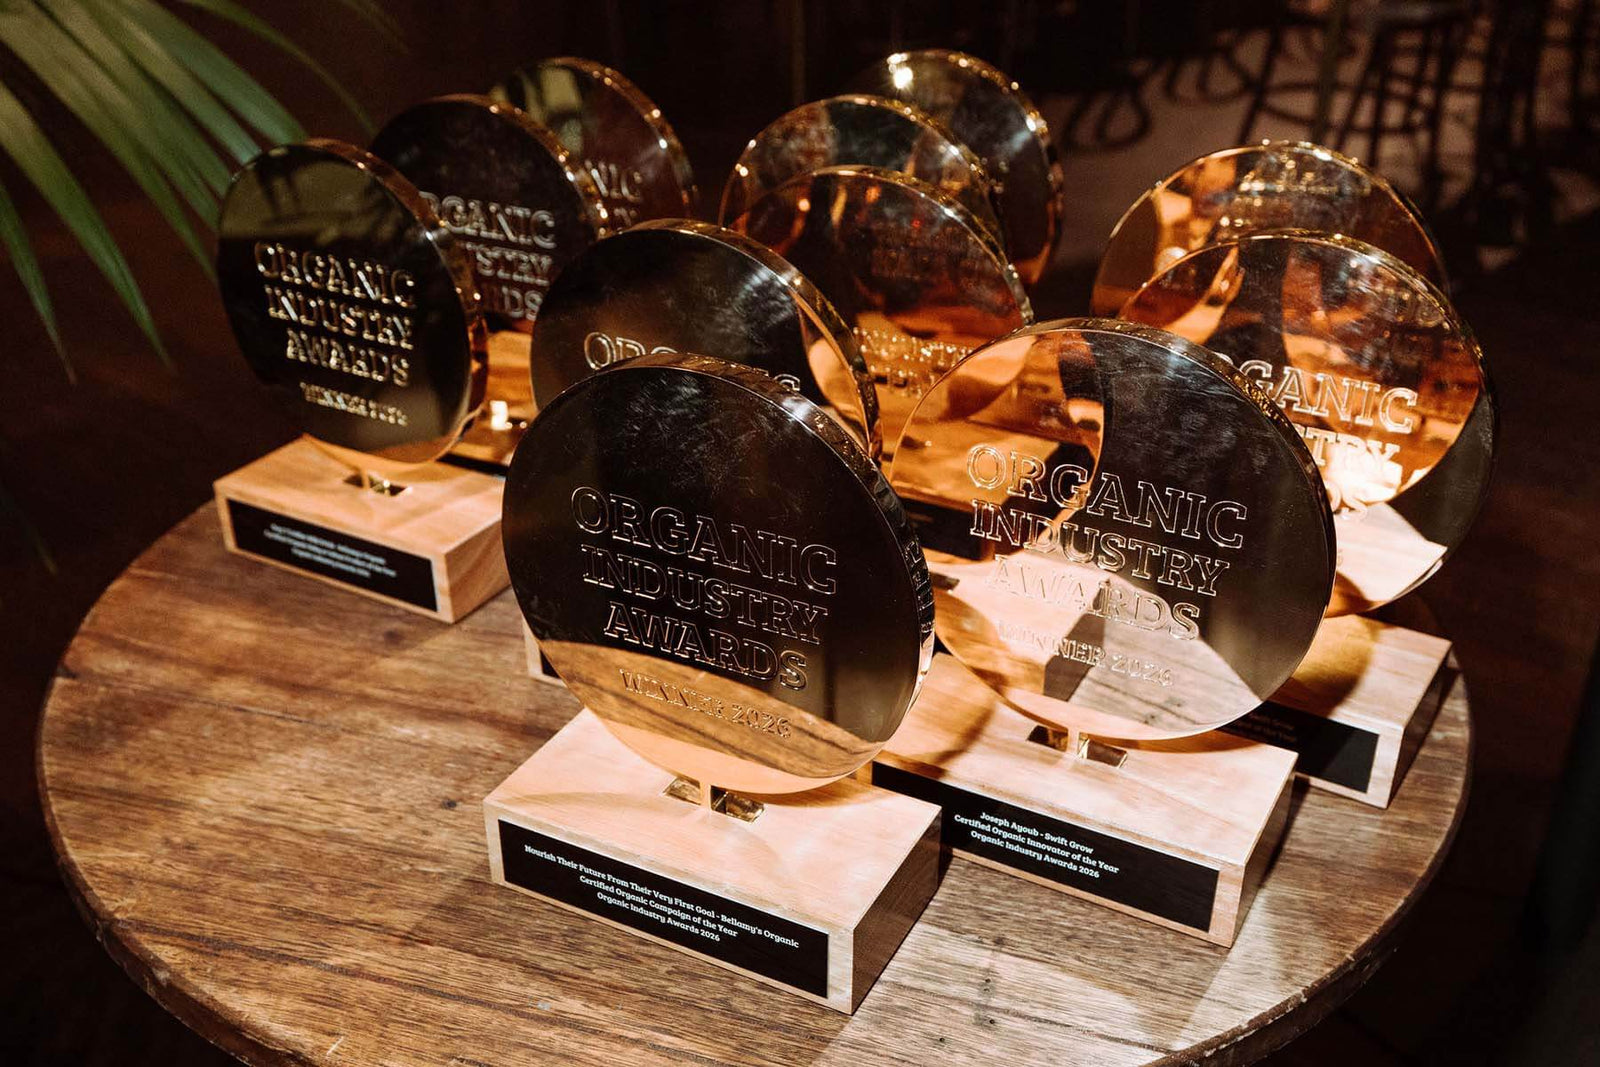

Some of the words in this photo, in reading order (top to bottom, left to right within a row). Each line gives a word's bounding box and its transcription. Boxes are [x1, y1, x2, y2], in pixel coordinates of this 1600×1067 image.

[419, 191, 557, 249] GANIC
[254, 241, 415, 307] ORGANIC
[264, 285, 414, 350] INDUSTRY
[286, 328, 409, 387] AWARDS
[1216, 352, 1418, 434] GANIC
[966, 444, 1248, 550] ORGANIC
[571, 486, 837, 595] ORGANIC
[970, 498, 1230, 597] INDUSTRY
[580, 543, 828, 645] INDUSTRY
[989, 554, 1200, 641] AWARDS
[604, 601, 808, 690] AWARDS
[998, 621, 1106, 668] WINNER
[1111, 651, 1174, 687] 2026
[619, 669, 727, 720] WINNER
[732, 704, 791, 738] 2026
[954, 814, 991, 832] Certified
[992, 827, 1026, 843] Organic
[1026, 838, 1071, 858] Innovator
[1071, 853, 1082, 861] of
[1082, 856, 1097, 867] the
[1098, 860, 1119, 874] Year
[971, 830, 1005, 847] Organic
[1005, 841, 1043, 861] Industry
[1044, 854, 1078, 871] Awards
[1079, 866, 1100, 879] 2026
[980, 812, 1010, 827] Joseph
[1010, 822, 1039, 836] Ayoub
[1044, 832, 1068, 846] Swift
[1069, 841, 1094, 854] Grow
[524, 845, 556, 862] Nourish
[556, 856, 578, 870] Their
[579, 864, 606, 880] Future
[607, 874, 629, 888] From
[630, 881, 652, 895] Their
[653, 890, 673, 904] Very
[674, 898, 694, 911] First
[696, 905, 715, 918] Goal
[721, 914, 762, 935] Bellamy's
[764, 930, 799, 948] Organic
[580, 875, 615, 893] Certified
[616, 888, 648, 905] Organic
[649, 900, 691, 920] Campaign
[692, 915, 701, 924] of
[702, 919, 716, 930] the
[717, 924, 738, 937] Year
[597, 892, 629, 909] Organic
[630, 904, 665, 923] Industry
[667, 917, 699, 934] Awards
[700, 928, 720, 941] 2026
